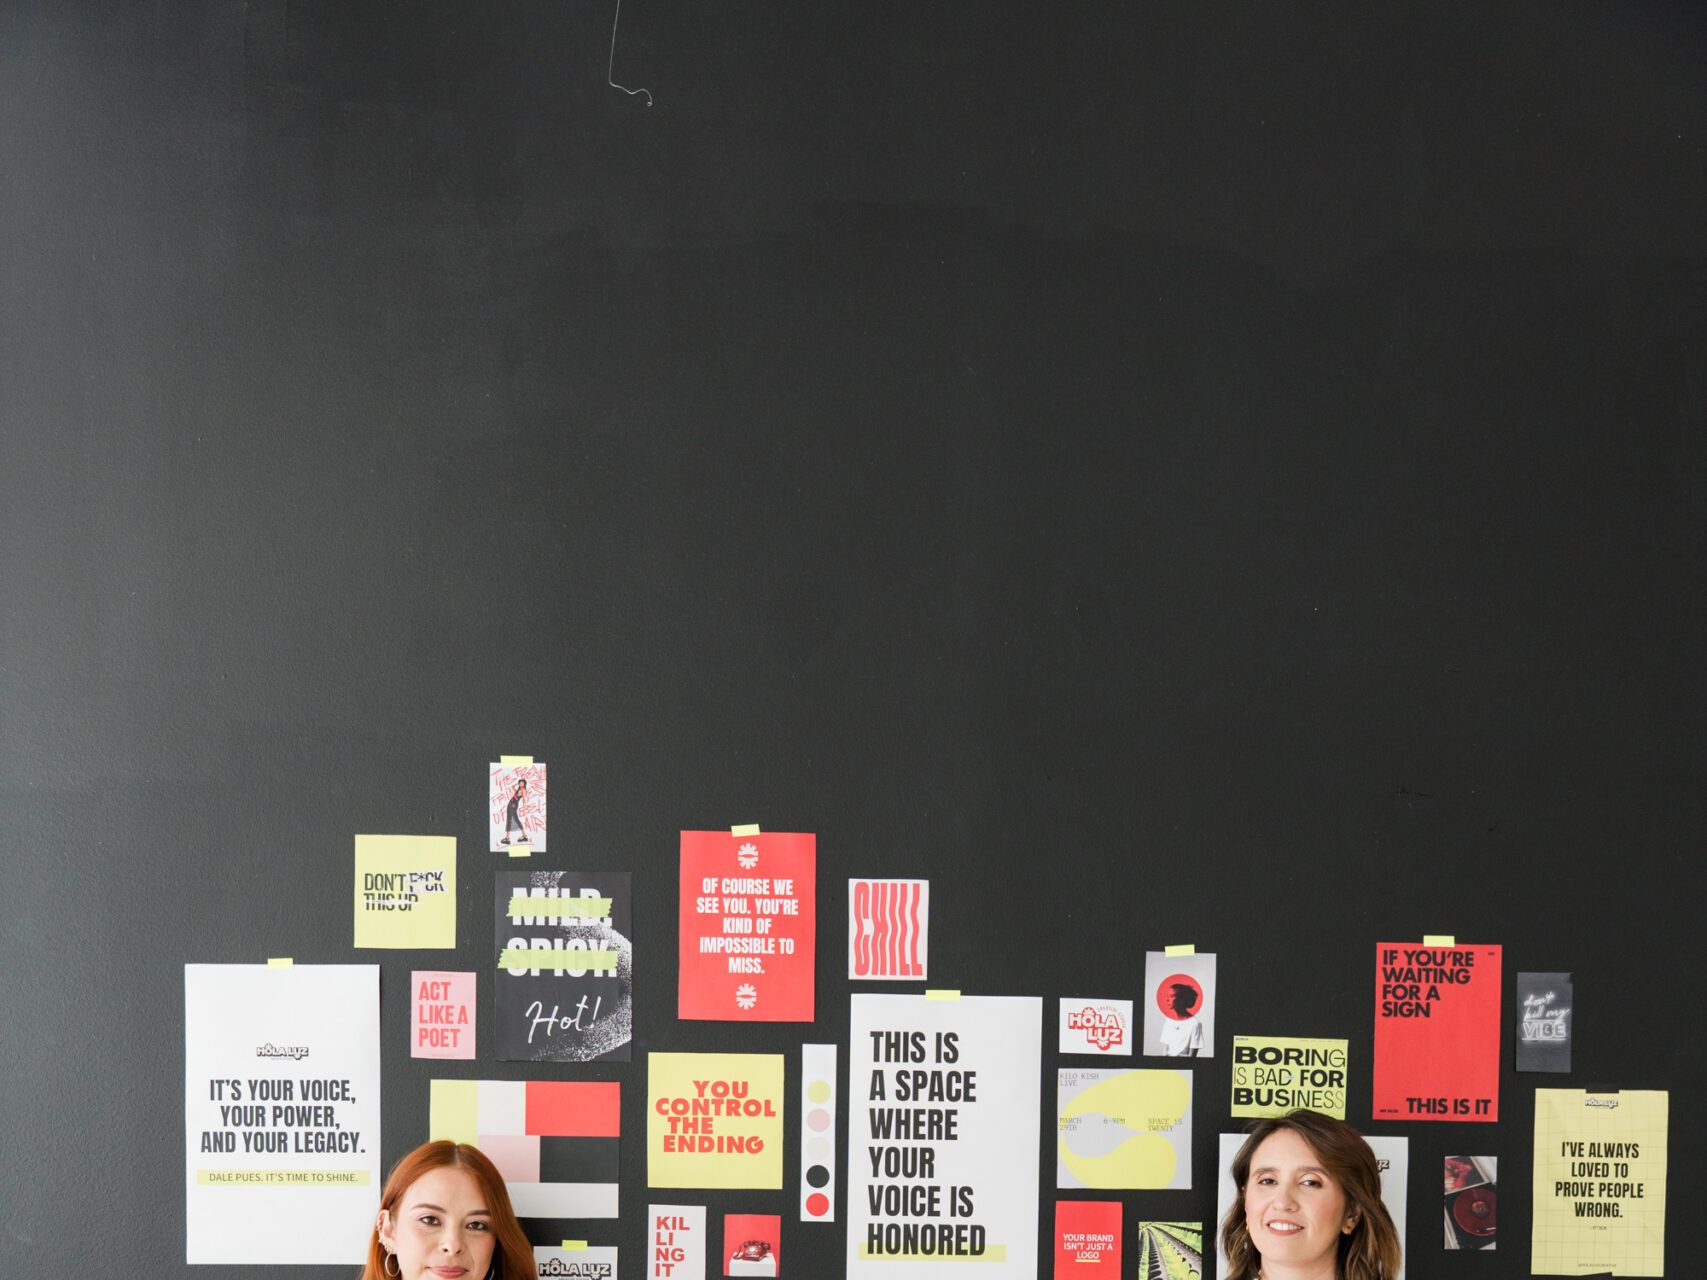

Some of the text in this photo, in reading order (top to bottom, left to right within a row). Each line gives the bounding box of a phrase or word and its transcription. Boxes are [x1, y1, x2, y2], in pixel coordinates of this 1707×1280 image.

[364, 873, 406, 891] DON'T
[702, 877, 793, 896] OF COURSE WE
[363, 892, 418, 911] THIS UP
[696, 897, 799, 915] SEE YOU. YOU'RE
[723, 917, 772, 934] KIND OF
[854, 882, 923, 976] CHILL
[699, 937, 794, 954] IMPOSSIBLE TO
[728, 957, 765, 974] MISS.
[1383, 950, 1474, 967] IF YOU'RE
[1382, 967, 1471, 984] WAITING
[419, 981, 451, 1001] ACT
[1382, 984, 1441, 1001] FOR A
[419, 1005, 468, 1024] LIKE A
[1068, 1007, 1119, 1030] HOLA
[1382, 1001, 1431, 1018] SIGN
[525, 995, 601, 1044] Hot!
[419, 1028, 461, 1047] POET
[1087, 1028, 1123, 1051] LUZ
[1523, 1022, 1566, 1039] VIBE
[257, 1043, 309, 1060] HOLA LUZ
[870, 1031, 959, 1064] THIS IS
[1235, 1046, 1346, 1068] BORING
[869, 1069, 977, 1103] A SPACE
[1234, 1066, 1344, 1088] IS BAD FOR
[210, 1079, 356, 1104] IT'S YOUR VOICE,
[693, 1080, 748, 1099] YOU
[1233, 1087, 1345, 1109] BUSINESS
[656, 1097, 776, 1117] CONTROL
[1406, 1098, 1492, 1115] THIS IS IT
[220, 1106, 340, 1129] YOUR POWER,
[667, 1117, 713, 1134] THE
[869, 1108, 958, 1140] WHERE
[201, 1131, 366, 1153] AND YOUR LEGACY.
[663, 1135, 764, 1154] ENDING
[1561, 1142, 1639, 1158] I'VE ALWAYS
[868, 1146, 935, 1178] YOUR
[1571, 1162, 1629, 1178] LOVED TO
[209, 1173, 233, 1182] DALE
[266, 1173, 284, 1182] IT'S
[287, 1173, 309, 1182] TIME
[311, 1173, 324, 1182] TO
[326, 1173, 358, 1182] SHINE.
[1555, 1182, 1644, 1198] PROVE PEOPLE
[868, 1185, 974, 1217] VOICE IS
[1574, 1202, 1623, 1218] WRONG.
[656, 1216, 690, 1230] KIL
[656, 1232, 673, 1246] LI
[867, 1223, 986, 1256] HONORED
[1063, 1233, 1114, 1242] YOUR BRAND
[1064, 1242, 1084, 1250] ISN'T
[1107, 1243, 1113, 1251] A
[656, 1248, 685, 1262] NG
[1077, 1251, 1099, 1259] LOGO
[539, 1258, 581, 1277] HOLA
[655, 1263, 674, 1277] IT
